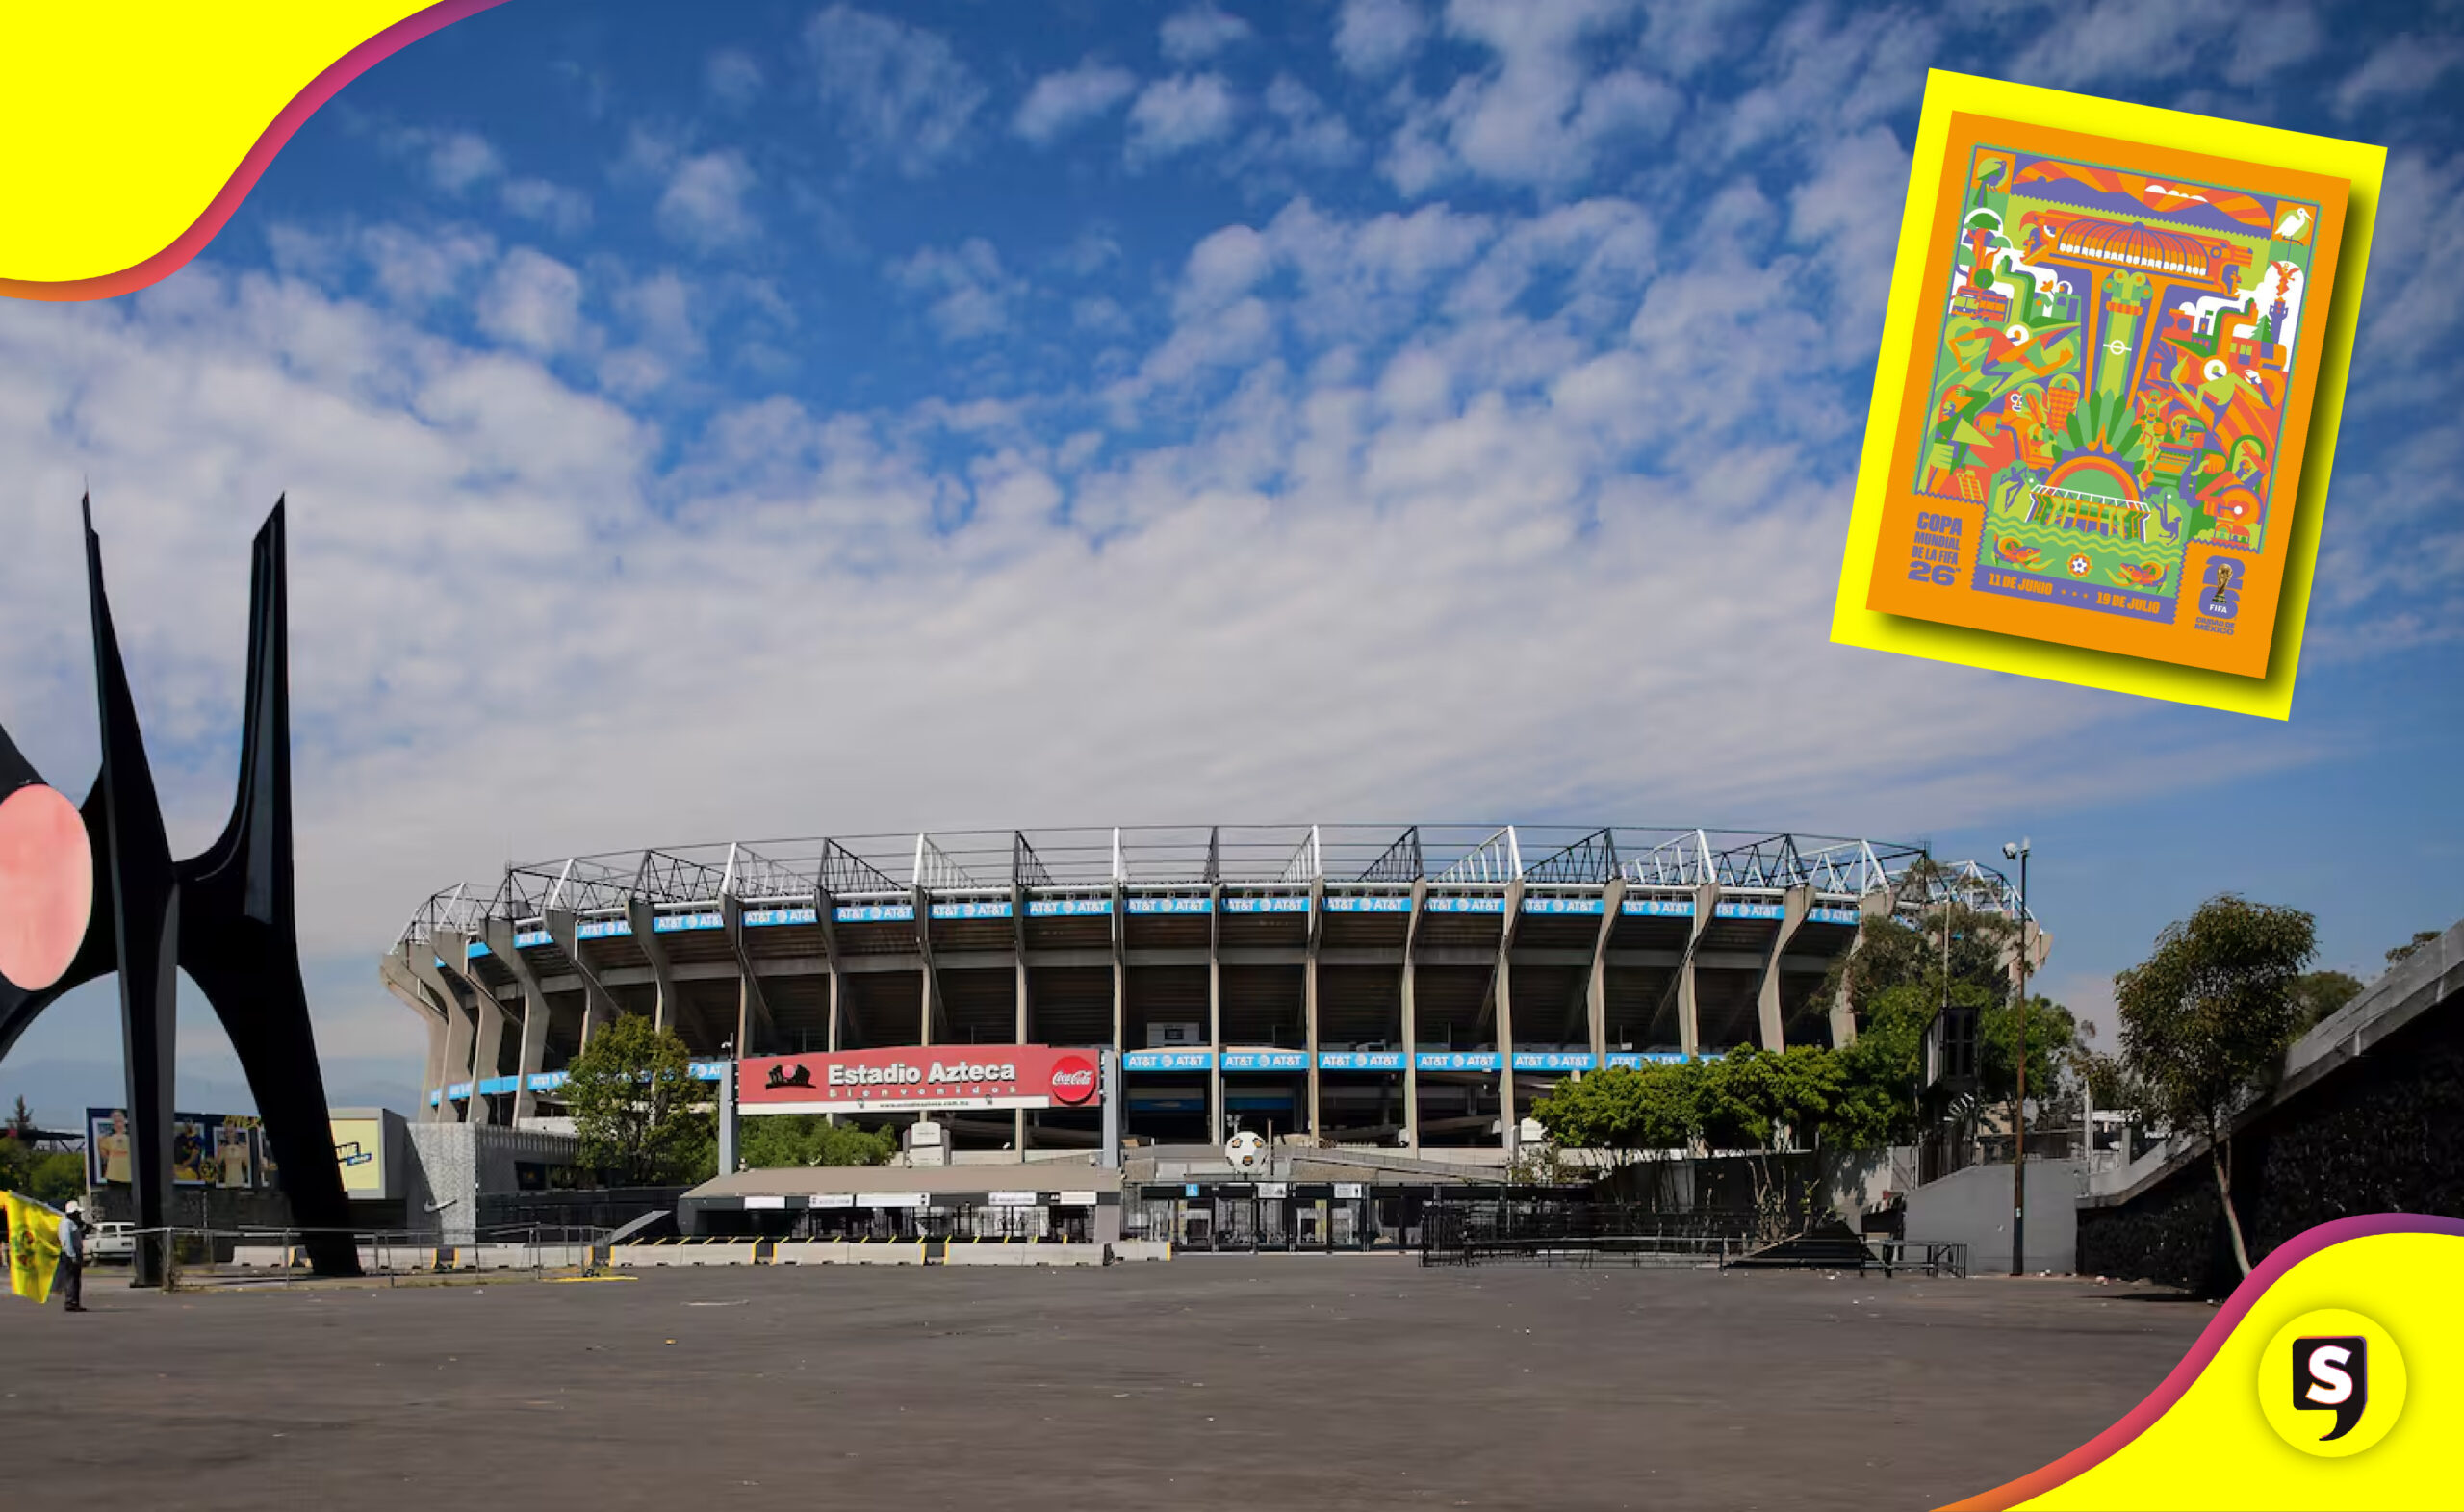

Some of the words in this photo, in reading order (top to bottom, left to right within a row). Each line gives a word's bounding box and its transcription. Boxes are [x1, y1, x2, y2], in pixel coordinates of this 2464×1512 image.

[932, 905, 961, 916] AT&T
[978, 904, 1006, 915] AT&T
[1030, 902, 1059, 913] AT&T
[1077, 901, 1106, 912] AT&T
[1127, 900, 1156, 911] AT&T
[1175, 899, 1204, 910] AT&T
[1226, 900, 1255, 911] AT&T
[1273, 900, 1303, 910] AT&T
[1373, 900, 1402, 910] AT&T
[1470, 900, 1500, 910] AT&T
[1566, 900, 1595, 911] AT&T
[1662, 902, 1689, 913] AT&T
[1751, 905, 1778, 916] AT&T
[745, 912, 772, 924] AT&T
[837, 909, 865, 920] AT&T
[883, 907, 911, 918] AT&T
[1832, 910, 1855, 921] AT&T
[658, 916, 683, 929] AT&T
[1128, 1056, 1157, 1066] AT&T
[1175, 1056, 1204, 1066] AT&T
[1224, 1056, 1252, 1066] AT&T
[1272, 1056, 1301, 1066] AT&T
[1322, 1056, 1349, 1066] AT&T
[1369, 1056, 1398, 1066] AT&T
[1419, 1056, 1448, 1066] AT&T
[1466, 1056, 1495, 1066] AT&T
[1515, 1056, 1543, 1066] AT&T
[1560, 1056, 1589, 1066] AT&T
[828, 1063, 922, 1086] Estadio
[928, 1061, 1015, 1084] Azteca
